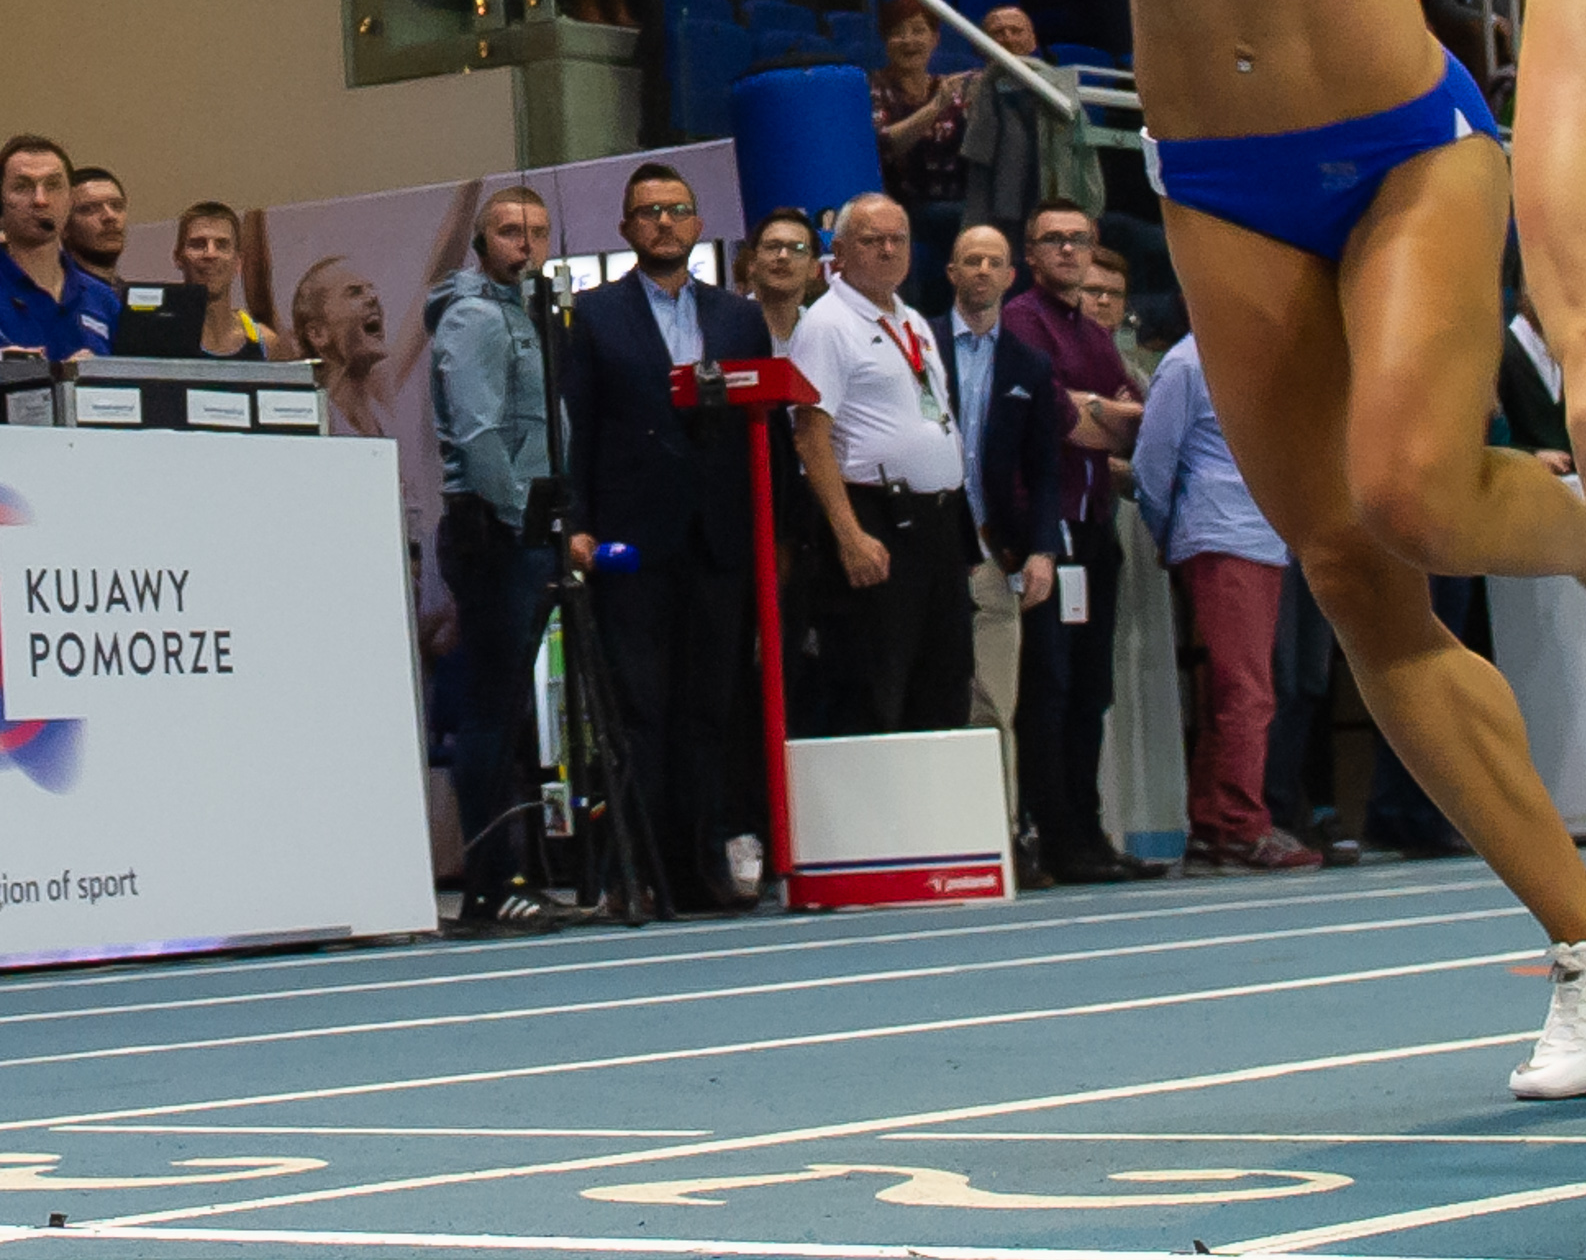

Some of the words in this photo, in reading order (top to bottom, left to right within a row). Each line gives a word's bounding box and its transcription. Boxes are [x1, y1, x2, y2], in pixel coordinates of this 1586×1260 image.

[25, 568, 190, 614] KUJAWY
[29, 630, 235, 677] POMORZE
[0, 873, 40, 906] ion
[46, 870, 71, 901] of
[77, 867, 140, 905] sport
